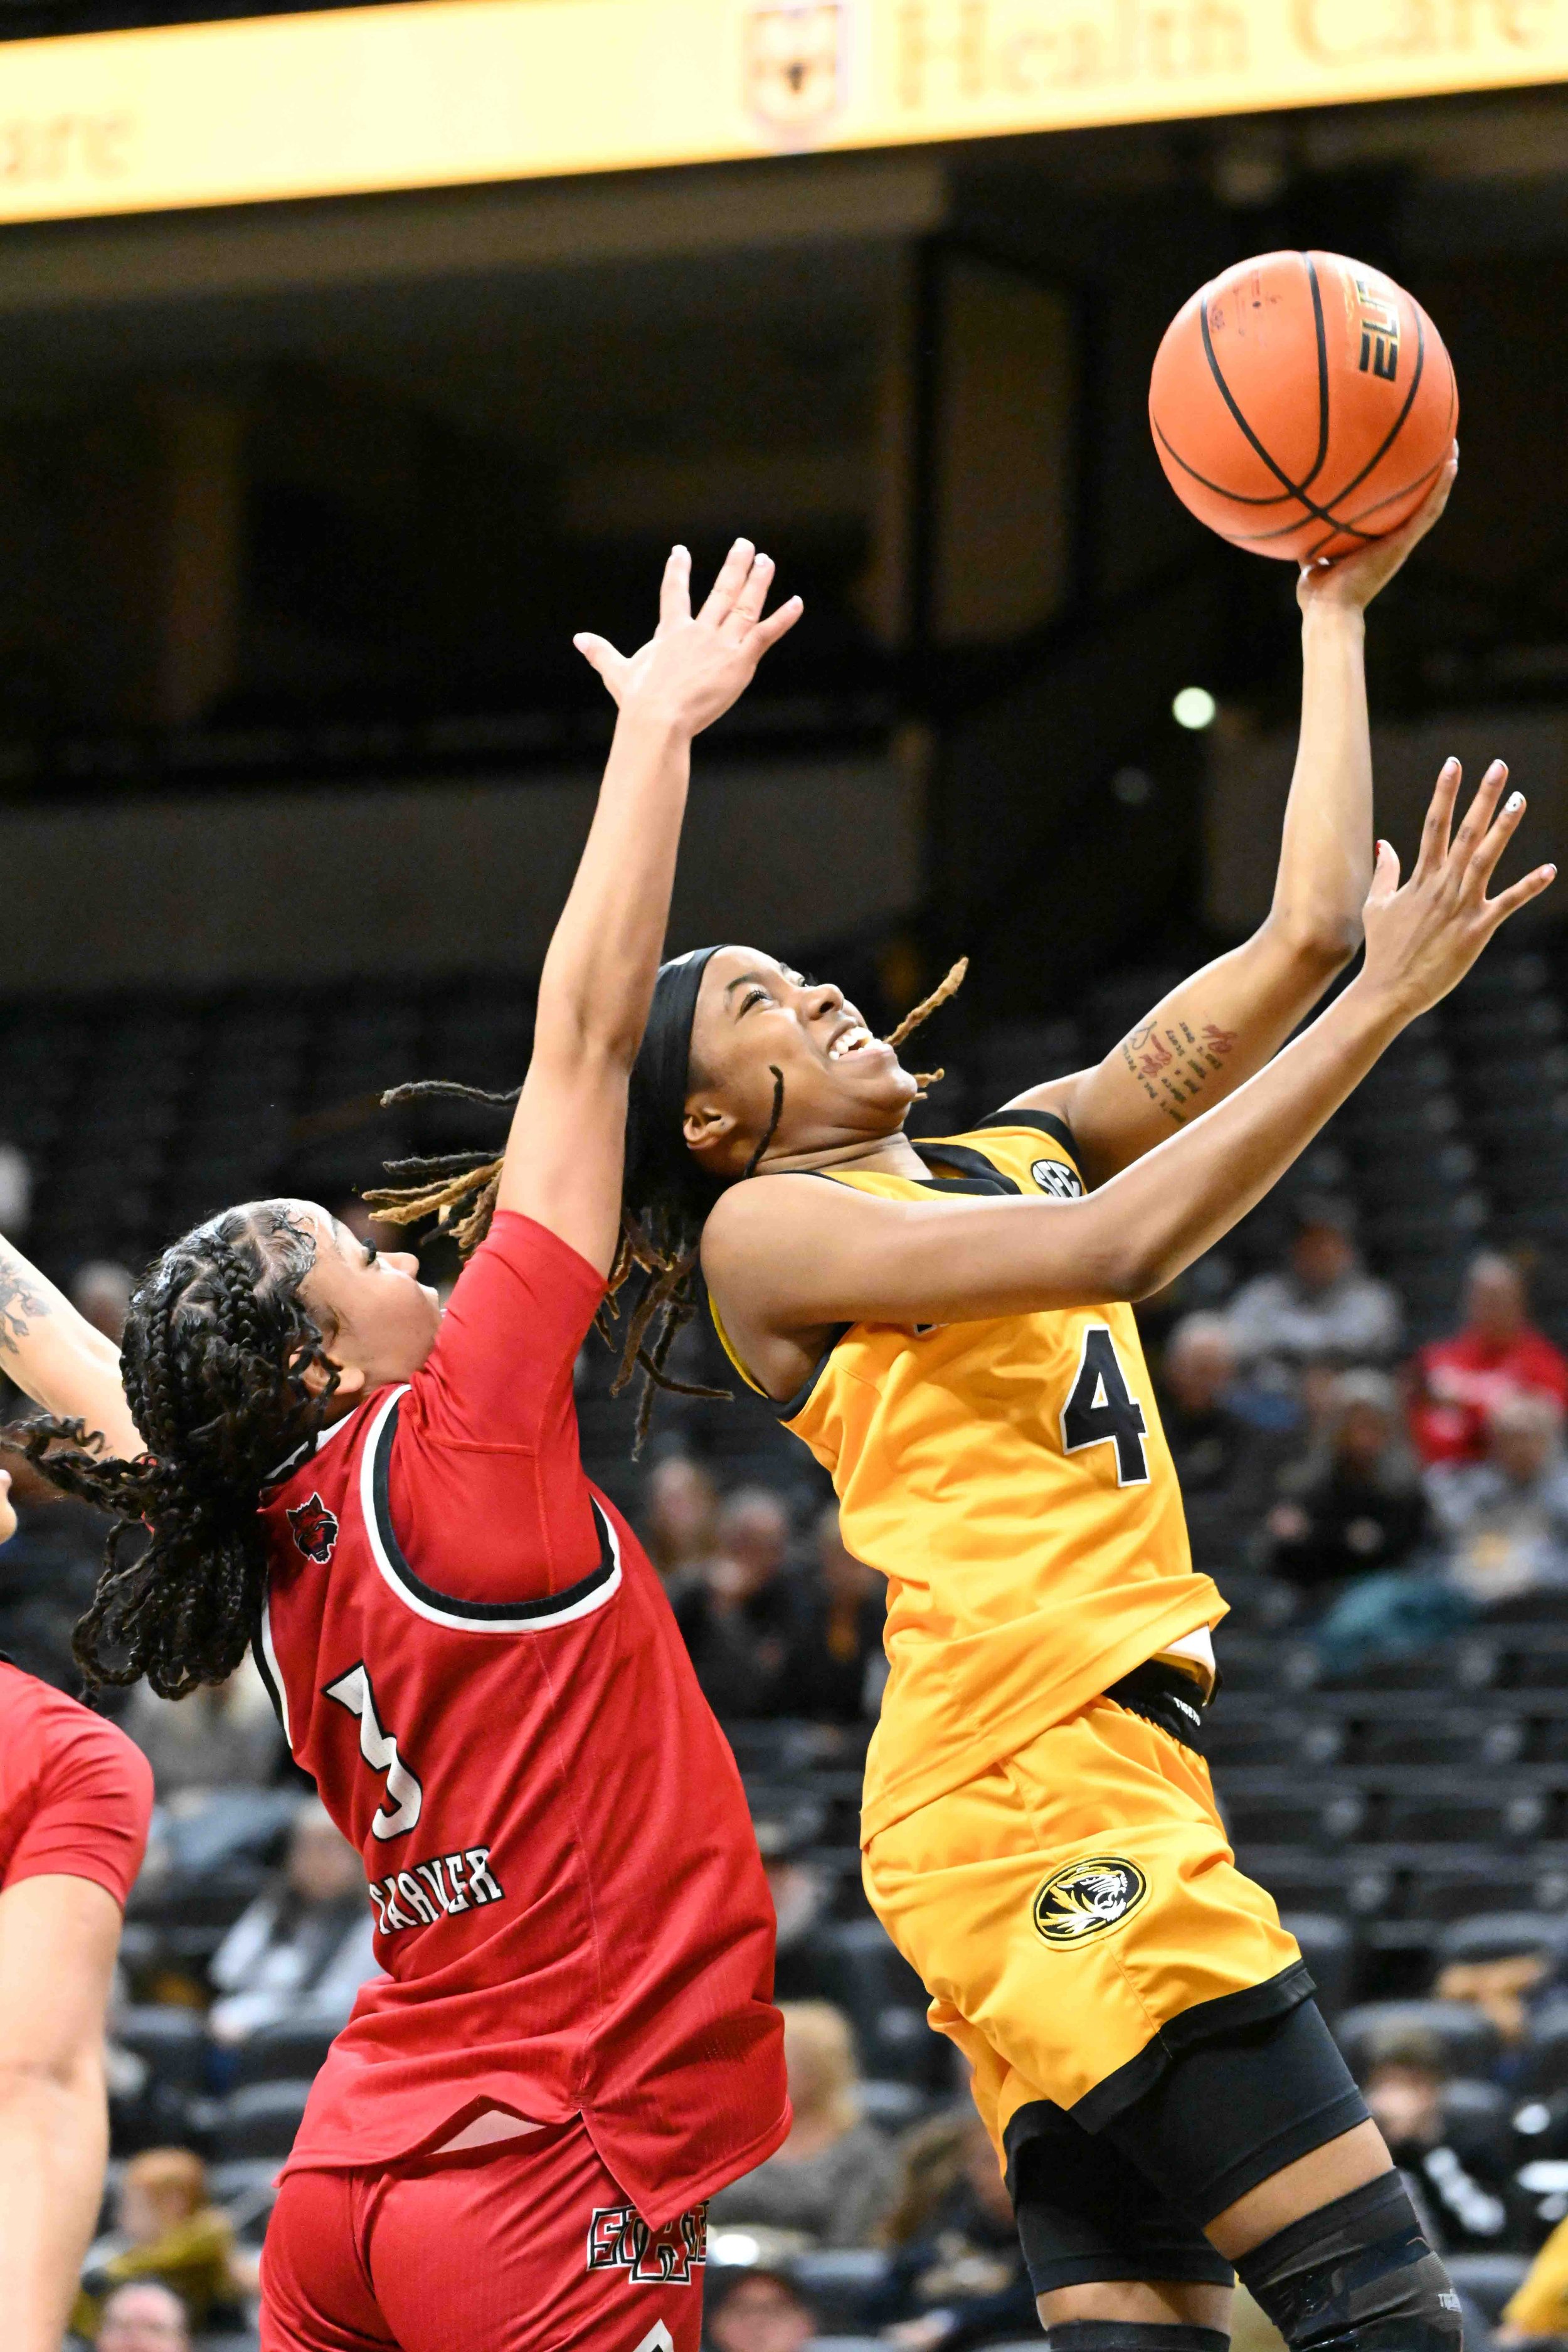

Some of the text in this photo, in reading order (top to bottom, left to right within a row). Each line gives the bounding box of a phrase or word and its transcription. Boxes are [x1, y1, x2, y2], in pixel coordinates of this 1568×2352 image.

[1033, 1161, 1081, 1198] SEC
[1059, 1324, 1151, 1487] 4
[320, 1659, 423, 1843] 3
